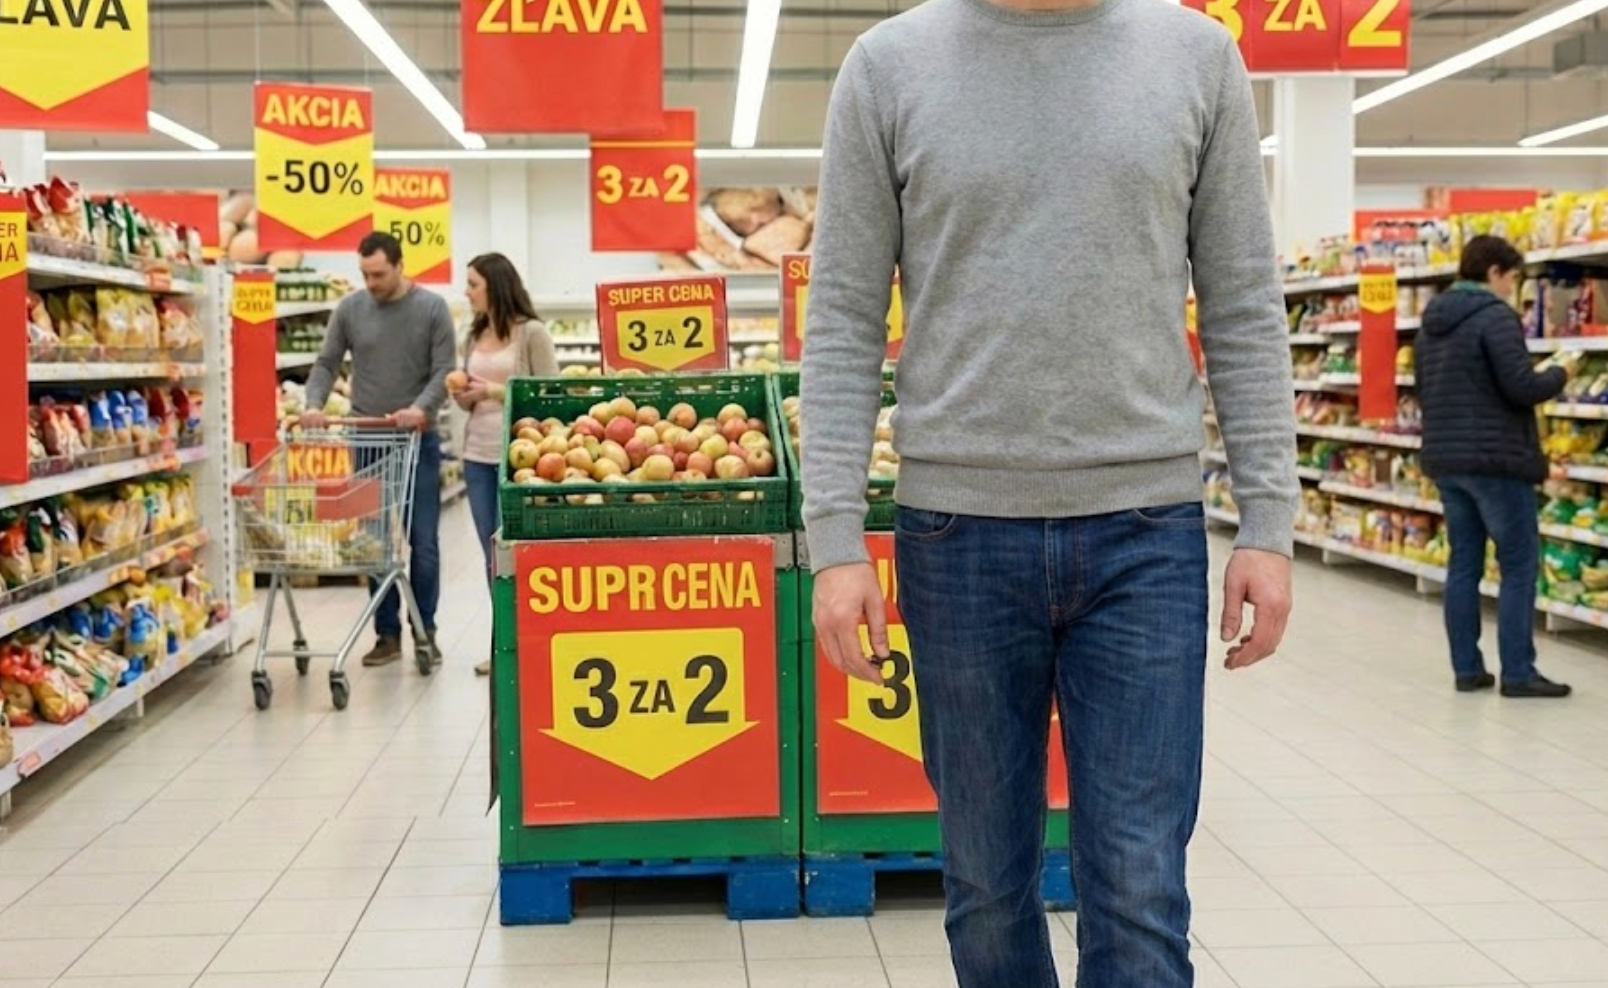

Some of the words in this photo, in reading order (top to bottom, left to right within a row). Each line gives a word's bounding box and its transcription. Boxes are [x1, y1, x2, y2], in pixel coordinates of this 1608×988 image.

[1263, 0, 1327, 31] ZA
[1348, 0, 1402, 47] 2
[261, 94, 365, 130] AKCIA
[265, 159, 364, 195] -50%
[374, 173, 447, 199] AKCIA
[596, 164, 623, 205] 3
[627, 176, 660, 198] ZA
[663, 163, 690, 203] 2
[608, 286, 665, 307] SUPER
[628, 320, 648, 352] 3
[654, 329, 676, 346] ZA
[682, 316, 704, 348] 2
[528, 565, 656, 614] SUPR
[662, 561, 762, 610] CENA
[573, 657, 619, 729] 3
[629, 679, 676, 714] ZA
[684, 654, 730, 725] 2
[868, 650, 912, 720] 3
